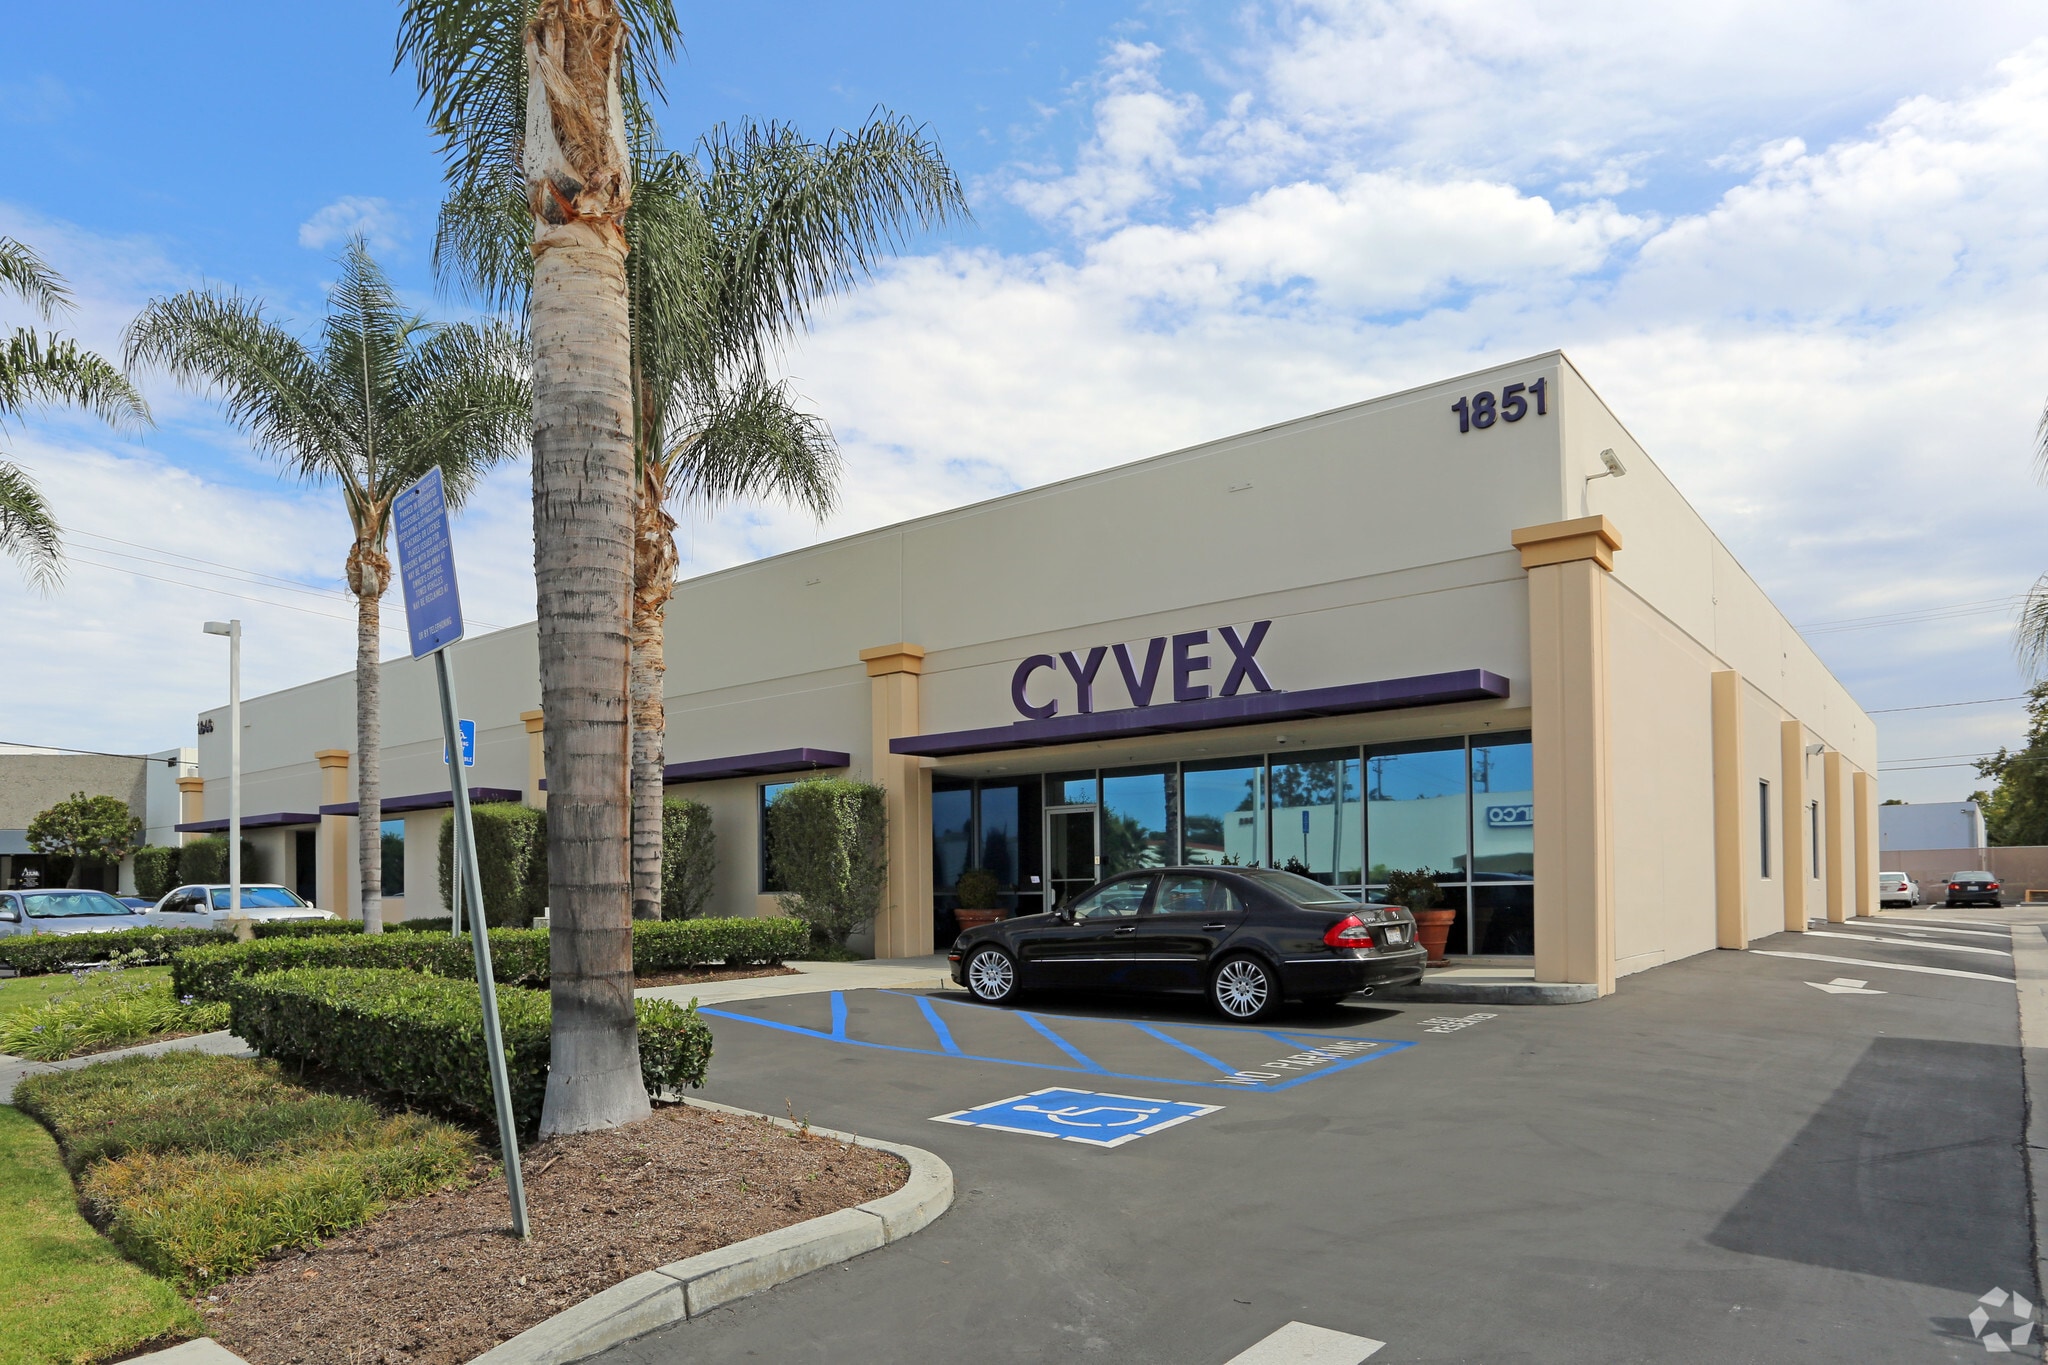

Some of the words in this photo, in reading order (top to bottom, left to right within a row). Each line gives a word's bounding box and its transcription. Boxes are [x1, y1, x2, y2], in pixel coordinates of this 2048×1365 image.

[1452, 377, 1546, 433] 1851
[1011, 620, 1272, 719] CYVEX
[1214, 1070, 1281, 1085] NO
[1261, 1040, 1378, 1071] PARKING
